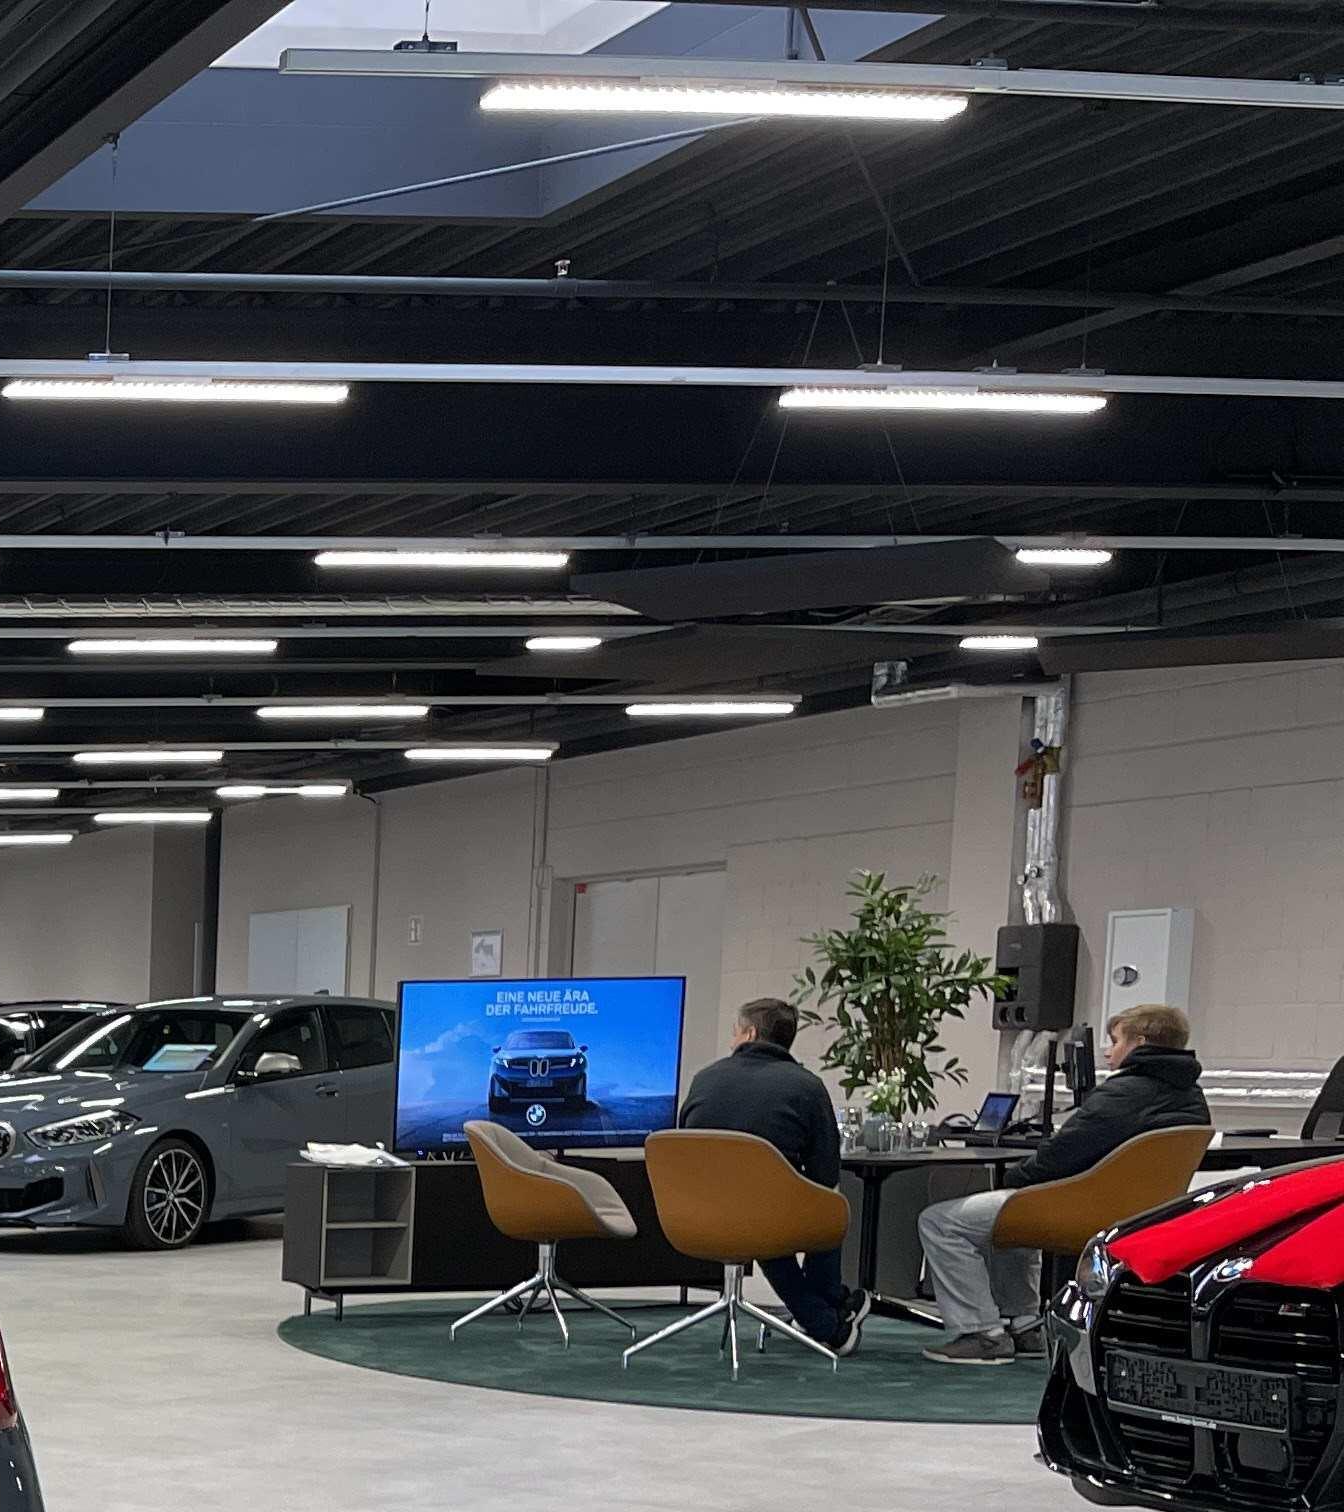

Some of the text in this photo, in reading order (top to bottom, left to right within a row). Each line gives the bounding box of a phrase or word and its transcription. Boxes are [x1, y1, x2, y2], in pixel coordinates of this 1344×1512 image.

[496, 988, 590, 1003] EINE NEUE ÄRA
[485, 1002, 599, 1016] DER FAHRFREUDE.
